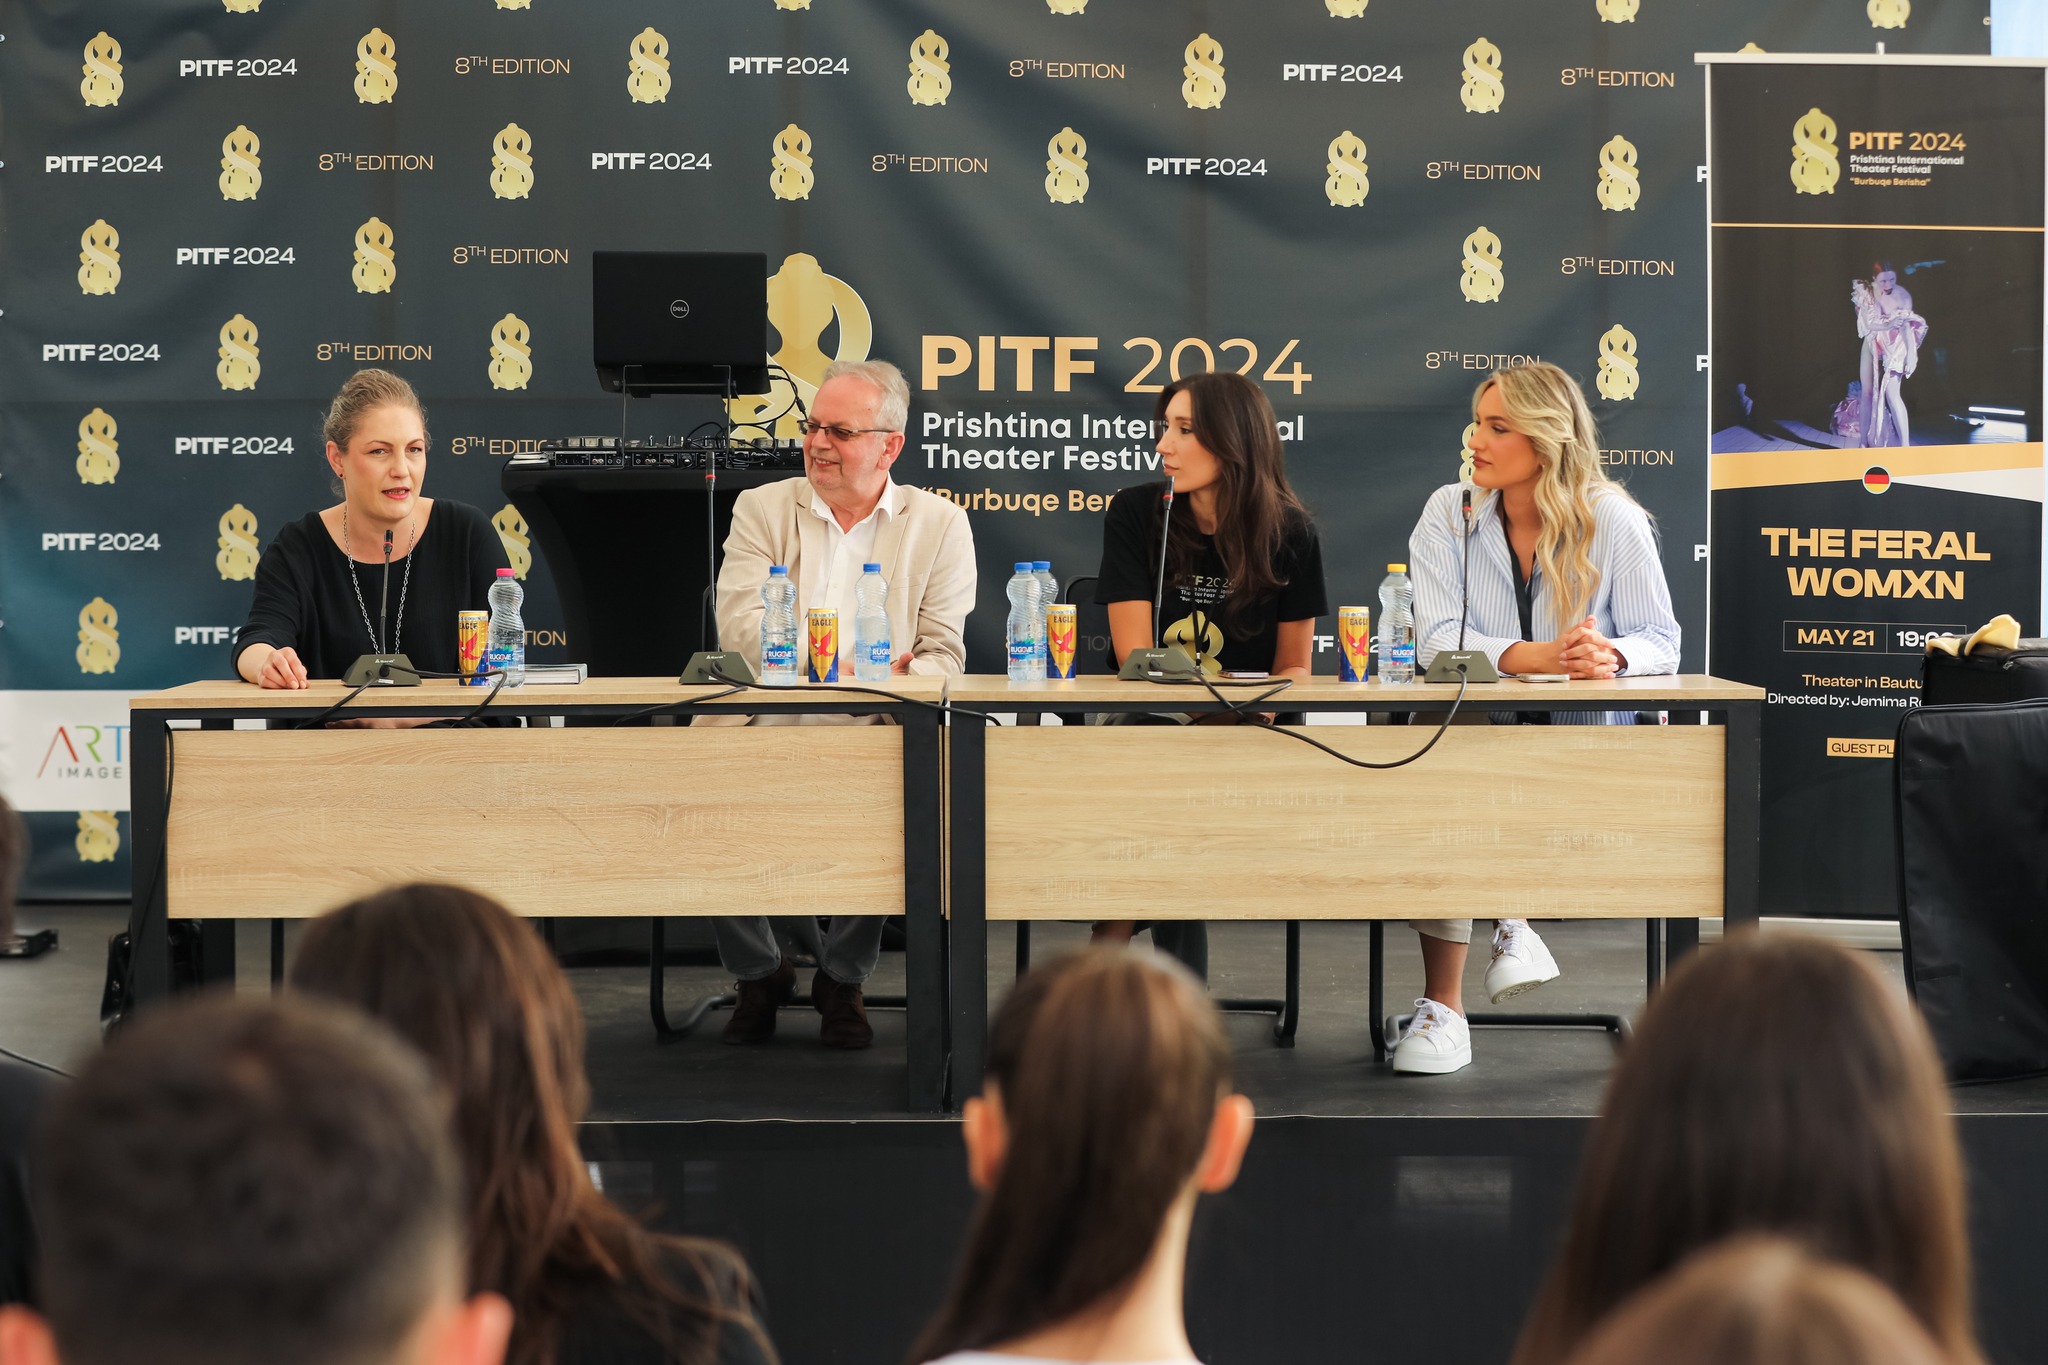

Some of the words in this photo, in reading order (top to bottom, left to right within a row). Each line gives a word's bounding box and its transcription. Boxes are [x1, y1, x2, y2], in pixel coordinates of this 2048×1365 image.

[180, 59, 234, 76] PITF
[236, 59, 298, 76] 2024
[492, 58, 570, 75] EDITION
[729, 57, 783, 74] PITF
[786, 57, 850, 75] 2024
[1046, 62, 1125, 79] EDITION
[1283, 64, 1337, 81] PITF
[1340, 65, 1404, 83] 2024
[1597, 71, 1675, 88] EDITION
[1849, 131, 1903, 150] PITF
[1908, 132, 1967, 152] 2024
[45, 155, 99, 172] PITF
[101, 155, 163, 173] 2024
[355, 155, 433, 171] EDITION
[592, 153, 645, 170] PITF
[648, 153, 712, 171] 2024
[909, 157, 988, 173] EDITION
[1147, 158, 1201, 175] PITF
[1204, 158, 1268, 176] 2024
[1850, 154, 1895, 164] Prishtina
[1897, 155, 1964, 165] International
[1463, 164, 1541, 181] EDITION
[1850, 164, 1890, 173] Theater
[1891, 165, 1931, 174] Festival
[176, 248, 230, 265] PITF
[232, 247, 295, 265] 2024
[490, 249, 569, 265] EDITION
[1598, 260, 1675, 276] EDITION
[43, 344, 96, 362] PITF
[98, 344, 161, 362] 2024
[353, 345, 432, 361] EDITION
[921, 335, 1098, 392] PITF
[923, 411, 1071, 439] Prishtina
[175, 437, 229, 455] PITF
[231, 437, 295, 455] 2024
[921, 443, 1055, 470] Theater
[1064, 444, 1164, 471] Festiv
[42, 533, 96, 551] PITF
[98, 533, 161, 551] 2024
[1761, 527, 1846, 557] THE
[1851, 529, 1991, 561] FERAL
[1786, 567, 1965, 600] WOMXN
[175, 627, 229, 644] PITF
[1797, 628, 1850, 645] MAY
[1852, 630, 1875, 646] 21
[1802, 674, 1862, 689] Theater
[1865, 676, 1878, 688] in
[1880, 677, 1923, 690] Bautu
[1768, 693, 1827, 706] Directed
[1829, 694, 1850, 708] by:
[1851, 696, 1906, 708] Jemima
[37, 726, 130, 778] ART
[1831, 742, 1876, 754] GUEST
[57, 767, 122, 779] IMAGE
